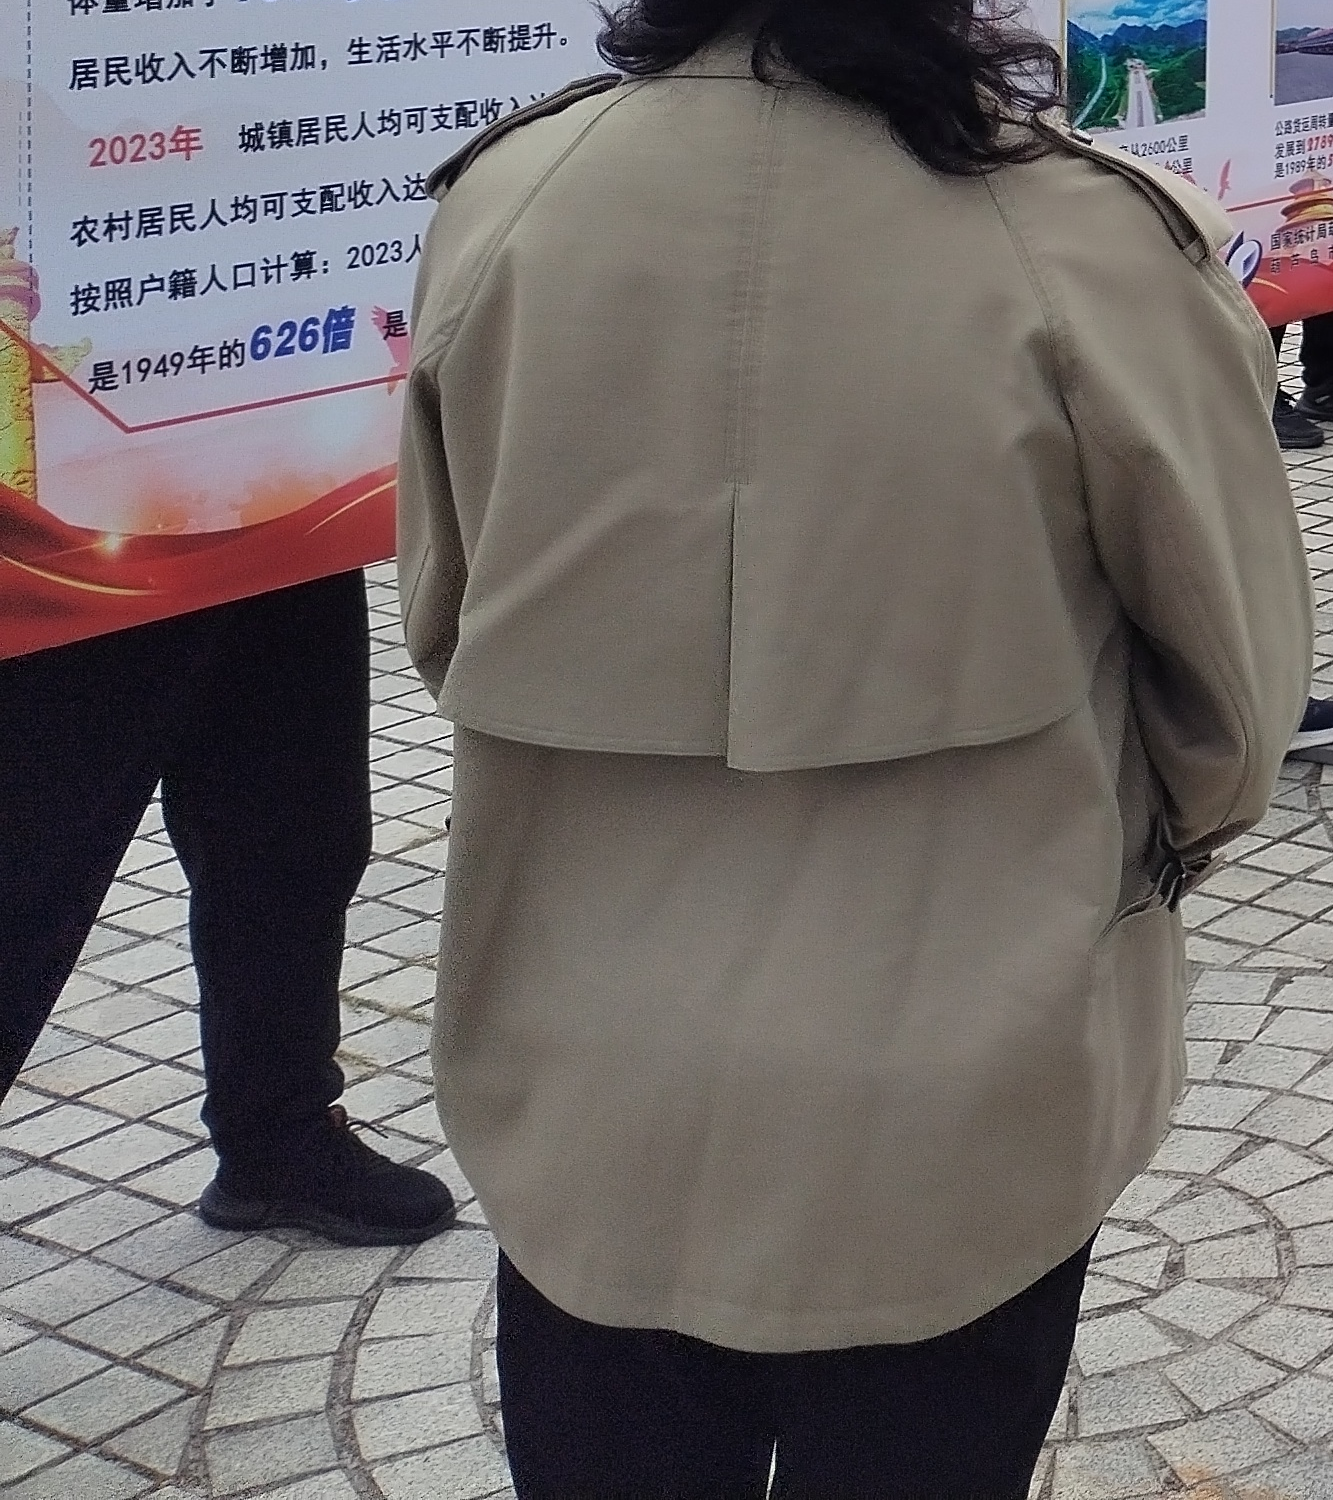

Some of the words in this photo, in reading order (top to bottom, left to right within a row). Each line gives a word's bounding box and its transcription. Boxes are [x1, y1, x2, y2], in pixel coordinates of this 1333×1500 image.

[89, 124, 204, 168] 2023年
[69, 171, 427, 249] 农村居民人均可支配收入达
[88, 304, 357, 395] 是1949年的626倍
[382, 309, 409, 341] 是
